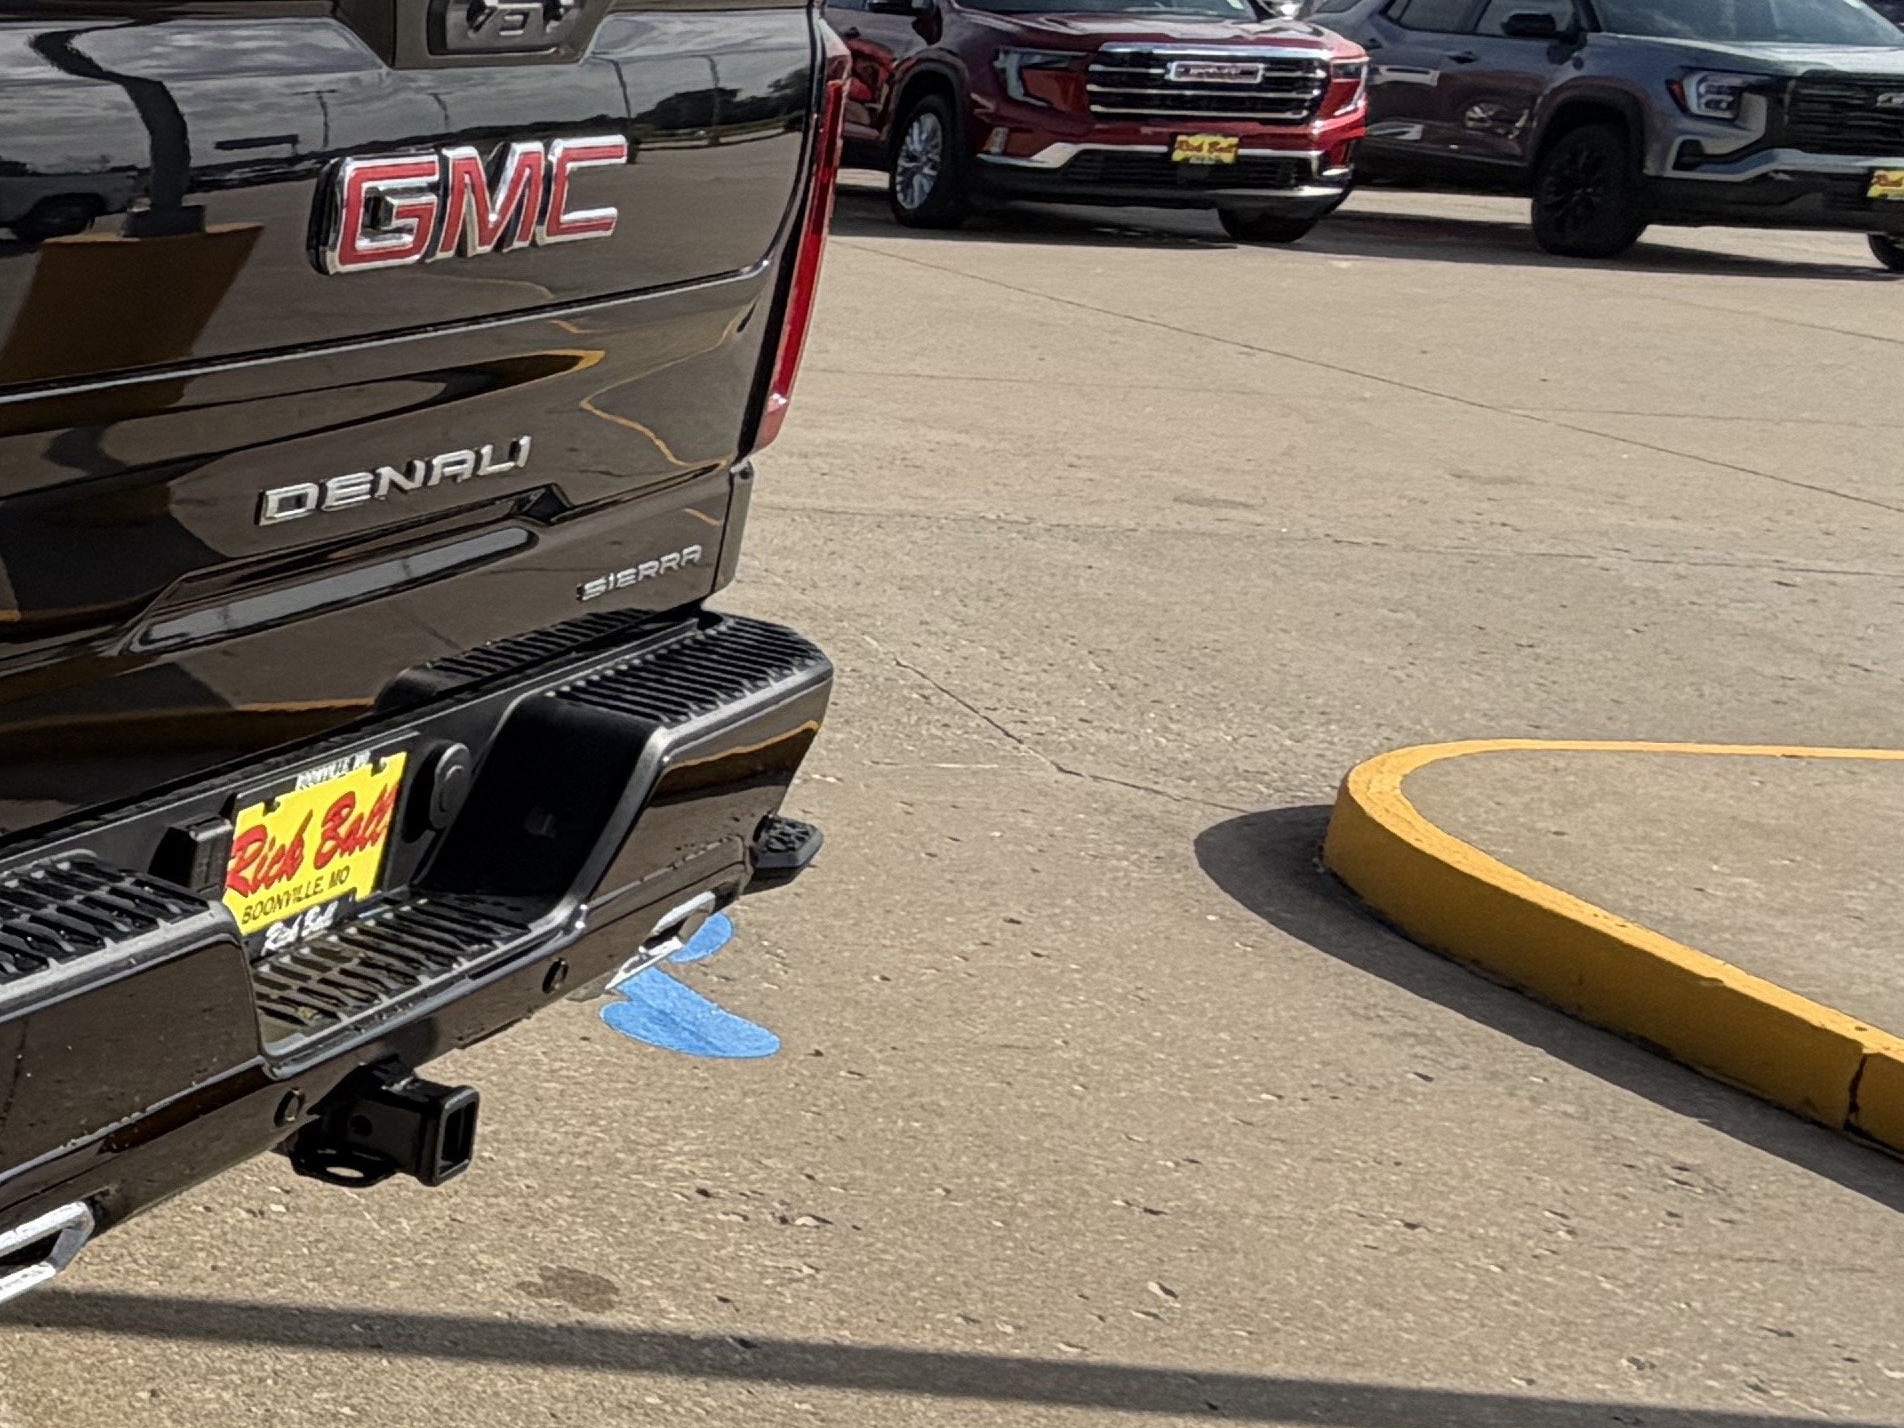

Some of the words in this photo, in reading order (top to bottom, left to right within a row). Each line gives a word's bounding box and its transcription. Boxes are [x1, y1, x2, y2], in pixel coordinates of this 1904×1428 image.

[320, 134, 629, 276] GMC
[255, 435, 532, 527] DENALI
[576, 543, 703, 602] SIERRA
[227, 809, 314, 899] Rick
[313, 781, 399, 870] Ball
